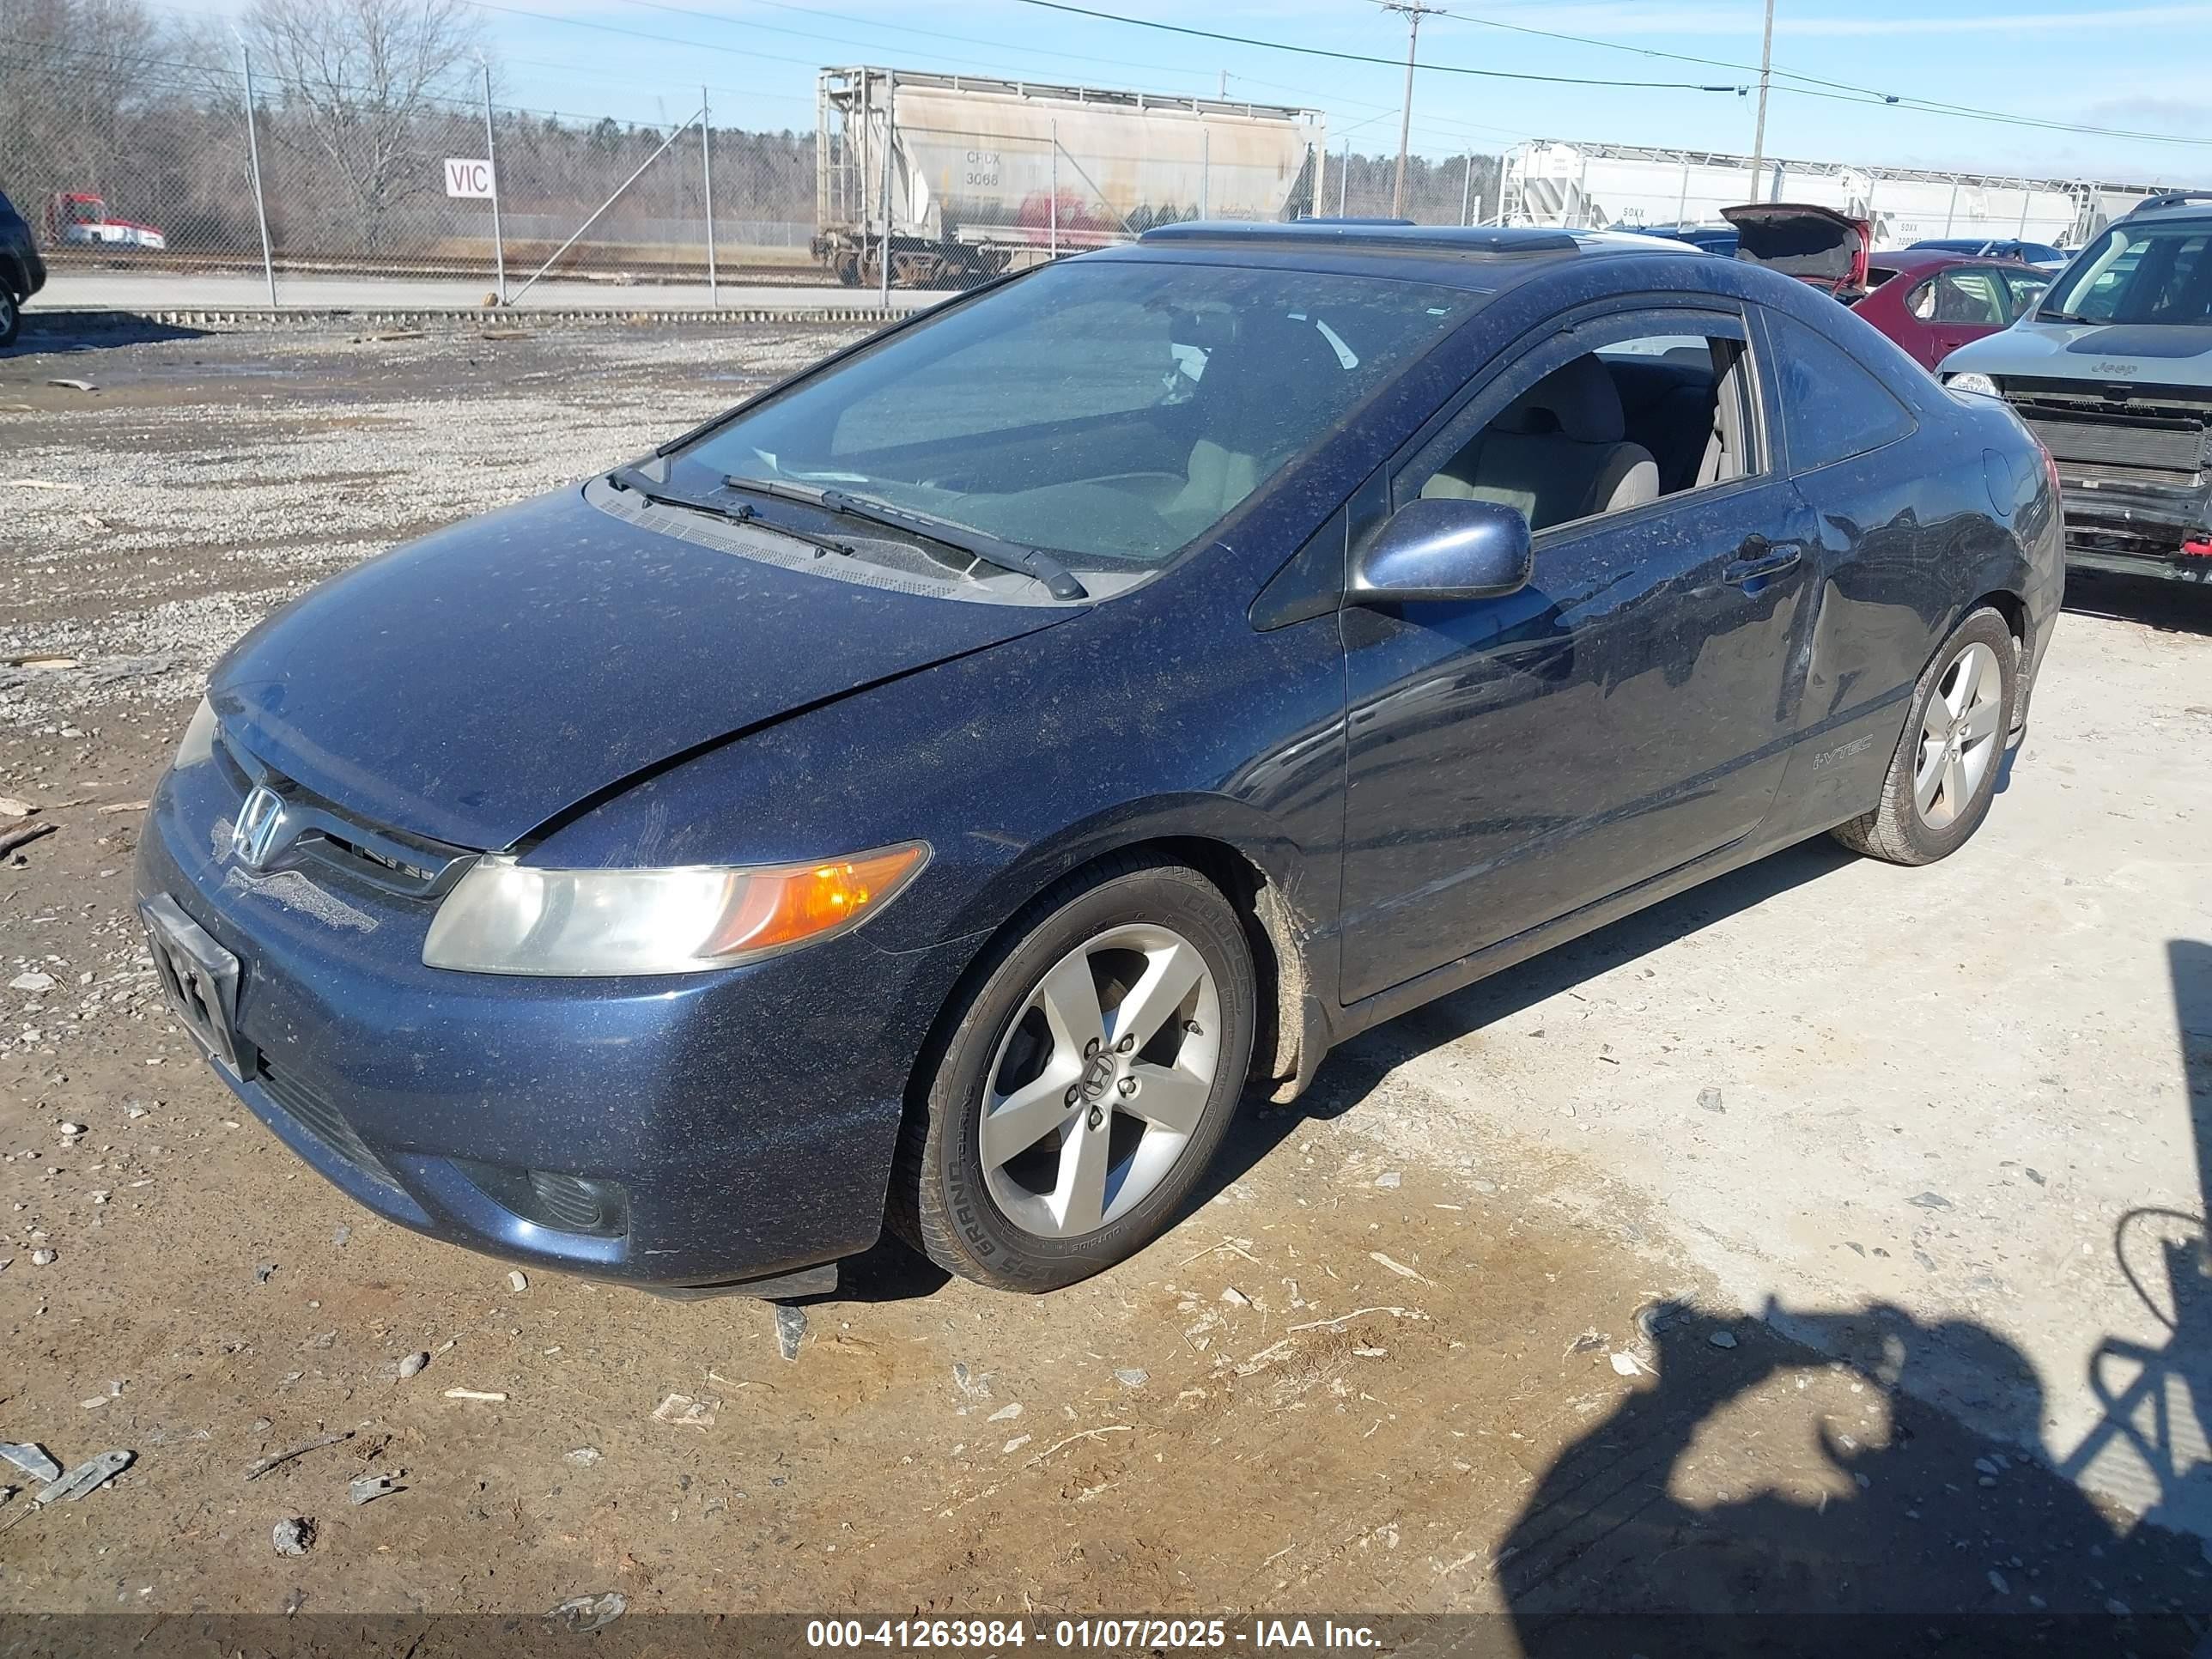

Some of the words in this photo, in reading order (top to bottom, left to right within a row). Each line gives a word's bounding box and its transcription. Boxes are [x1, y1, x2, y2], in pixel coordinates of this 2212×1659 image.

[451, 164, 488, 192] VIC
[949, 1161, 996, 1257] GRAND
[1071, 1226, 1121, 1253] OUTSIDE
